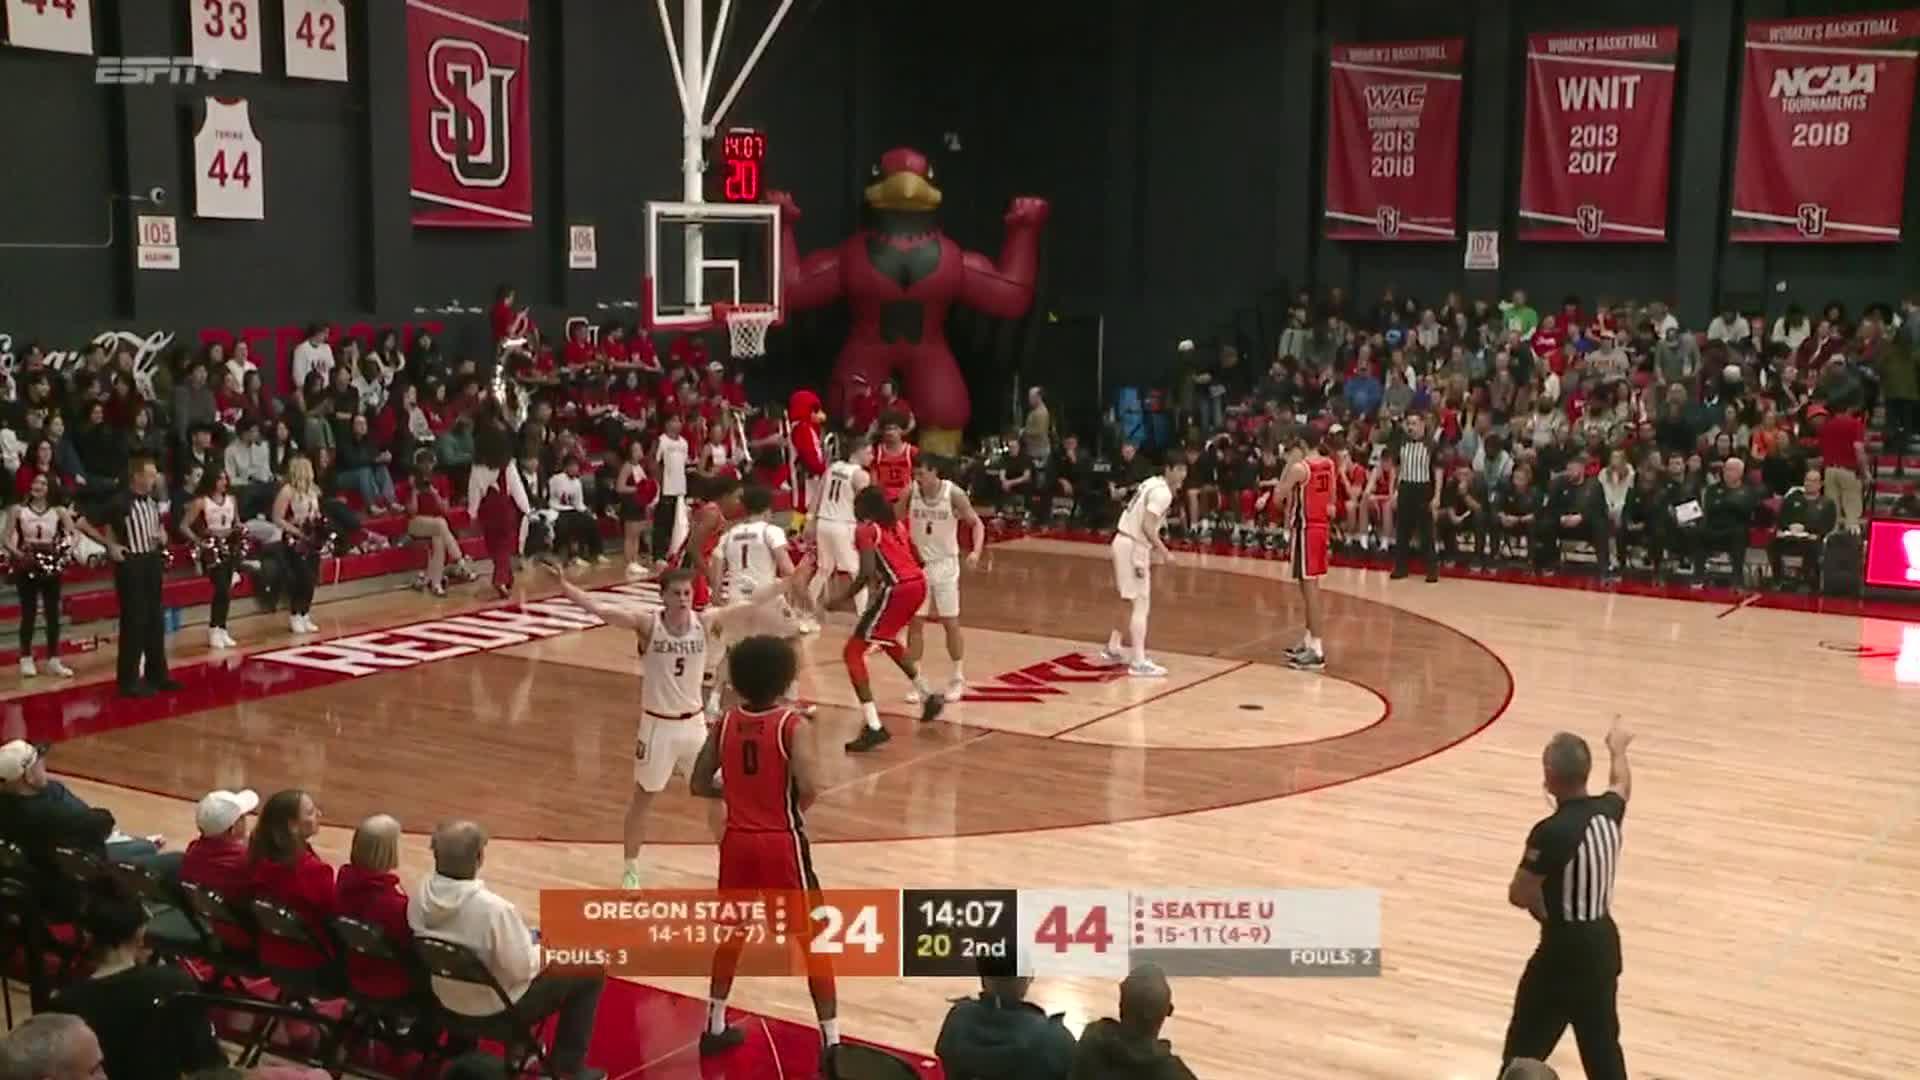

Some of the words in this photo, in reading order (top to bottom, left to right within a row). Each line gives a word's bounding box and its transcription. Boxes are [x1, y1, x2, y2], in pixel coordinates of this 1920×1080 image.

[204, 0, 247, 40] 33
[296, 12, 336, 51] 42
[1769, 23, 1823, 42] WOMEN'S
[1824, 18, 1900, 39] BASKETBALL
[1548, 37, 1595, 53] WOMEN'S
[1596, 34, 1658, 50] BASKETBALL
[1768, 63, 1876, 98] NCAA
[1364, 84, 1426, 112] WAC
[1558, 75, 1641, 111] WNIT
[1781, 95, 1867, 113] TOURNAMENTS
[1372, 131, 1415, 151] 2013
[1569, 125, 1618, 148] 2013
[1791, 122, 1851, 147] 2018
[724, 136, 763, 158] 14:07
[207, 149, 251, 188] 44
[1371, 156, 1415, 177] 2018
[1568, 151, 1617, 174] 2017
[726, 159, 757, 199] 20
[144, 222, 172, 244] 105
[573, 231, 593, 250] 106
[1471, 233, 1494, 256] 107
[674, 657, 687, 677] 5
[743, 739, 759, 775] 0
